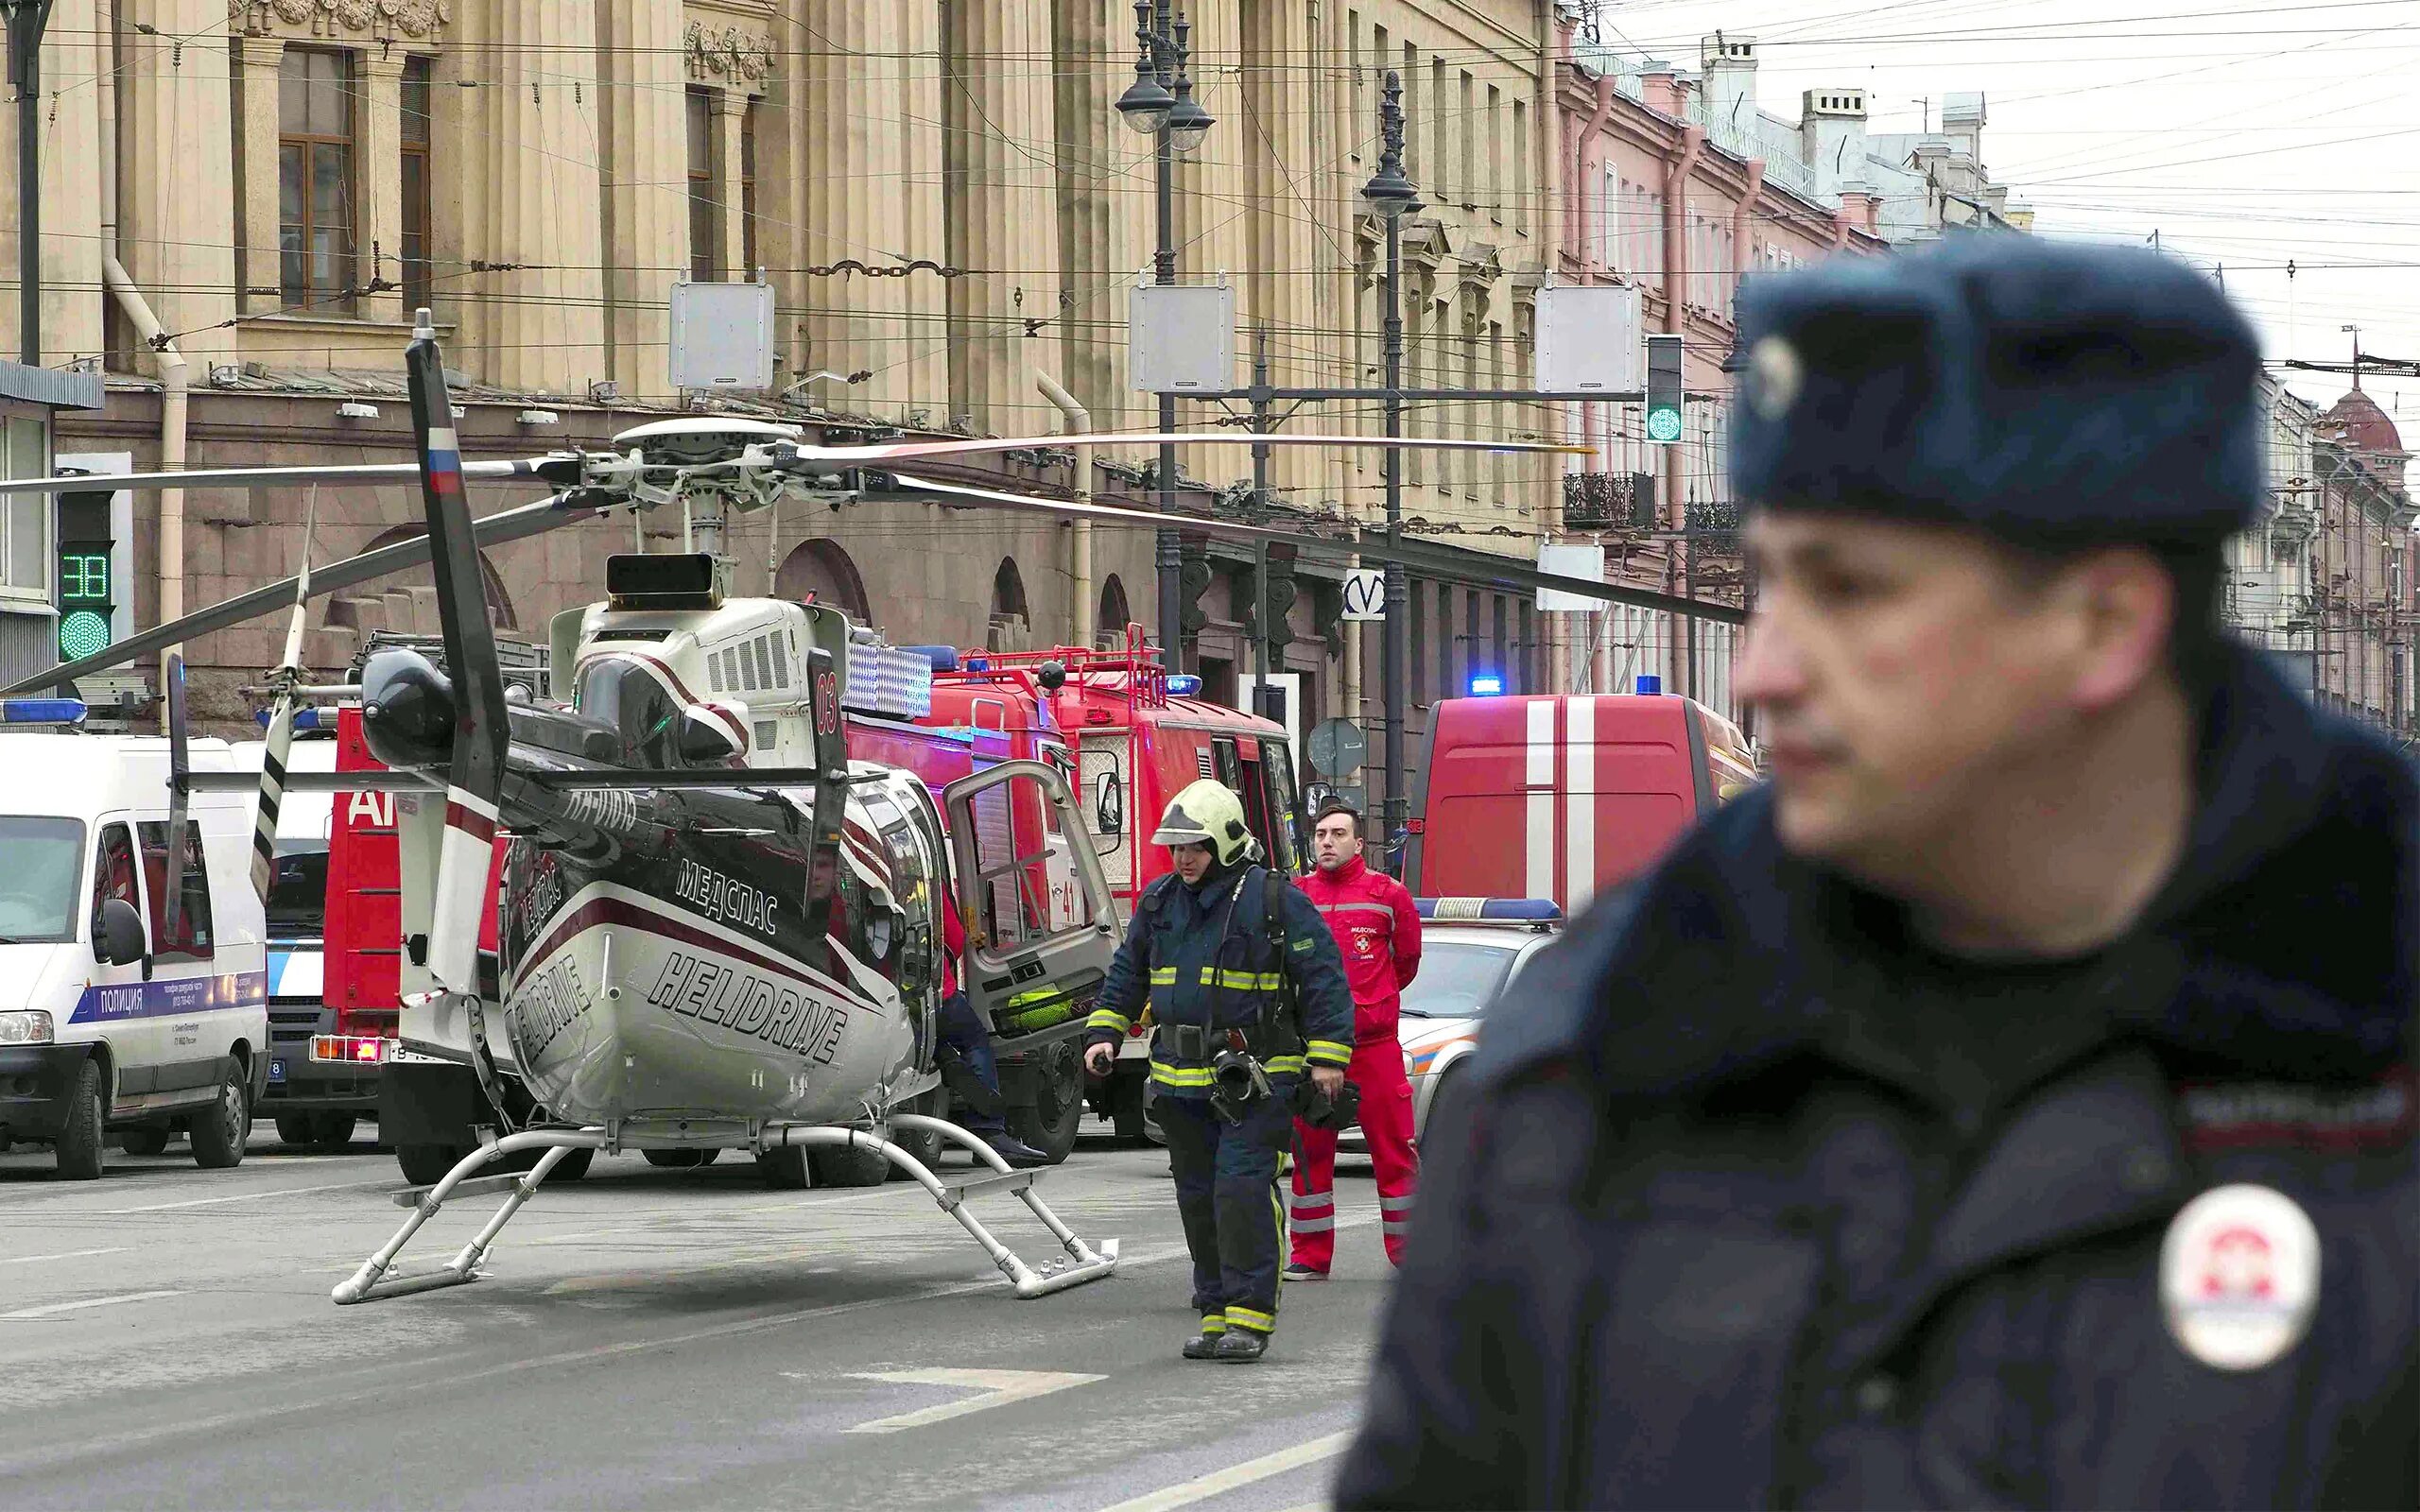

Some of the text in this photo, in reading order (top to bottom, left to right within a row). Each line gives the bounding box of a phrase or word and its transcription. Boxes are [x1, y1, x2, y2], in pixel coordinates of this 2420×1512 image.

[63, 556, 107, 597] 38
[816, 671, 838, 736] 03
[675, 857, 778, 936] МЕДСПАС
[1063, 881, 1075, 923] 41
[100, 987, 143, 1015] ПОЛИЦИЯ
[647, 952, 849, 1065] HELIDRIVE
